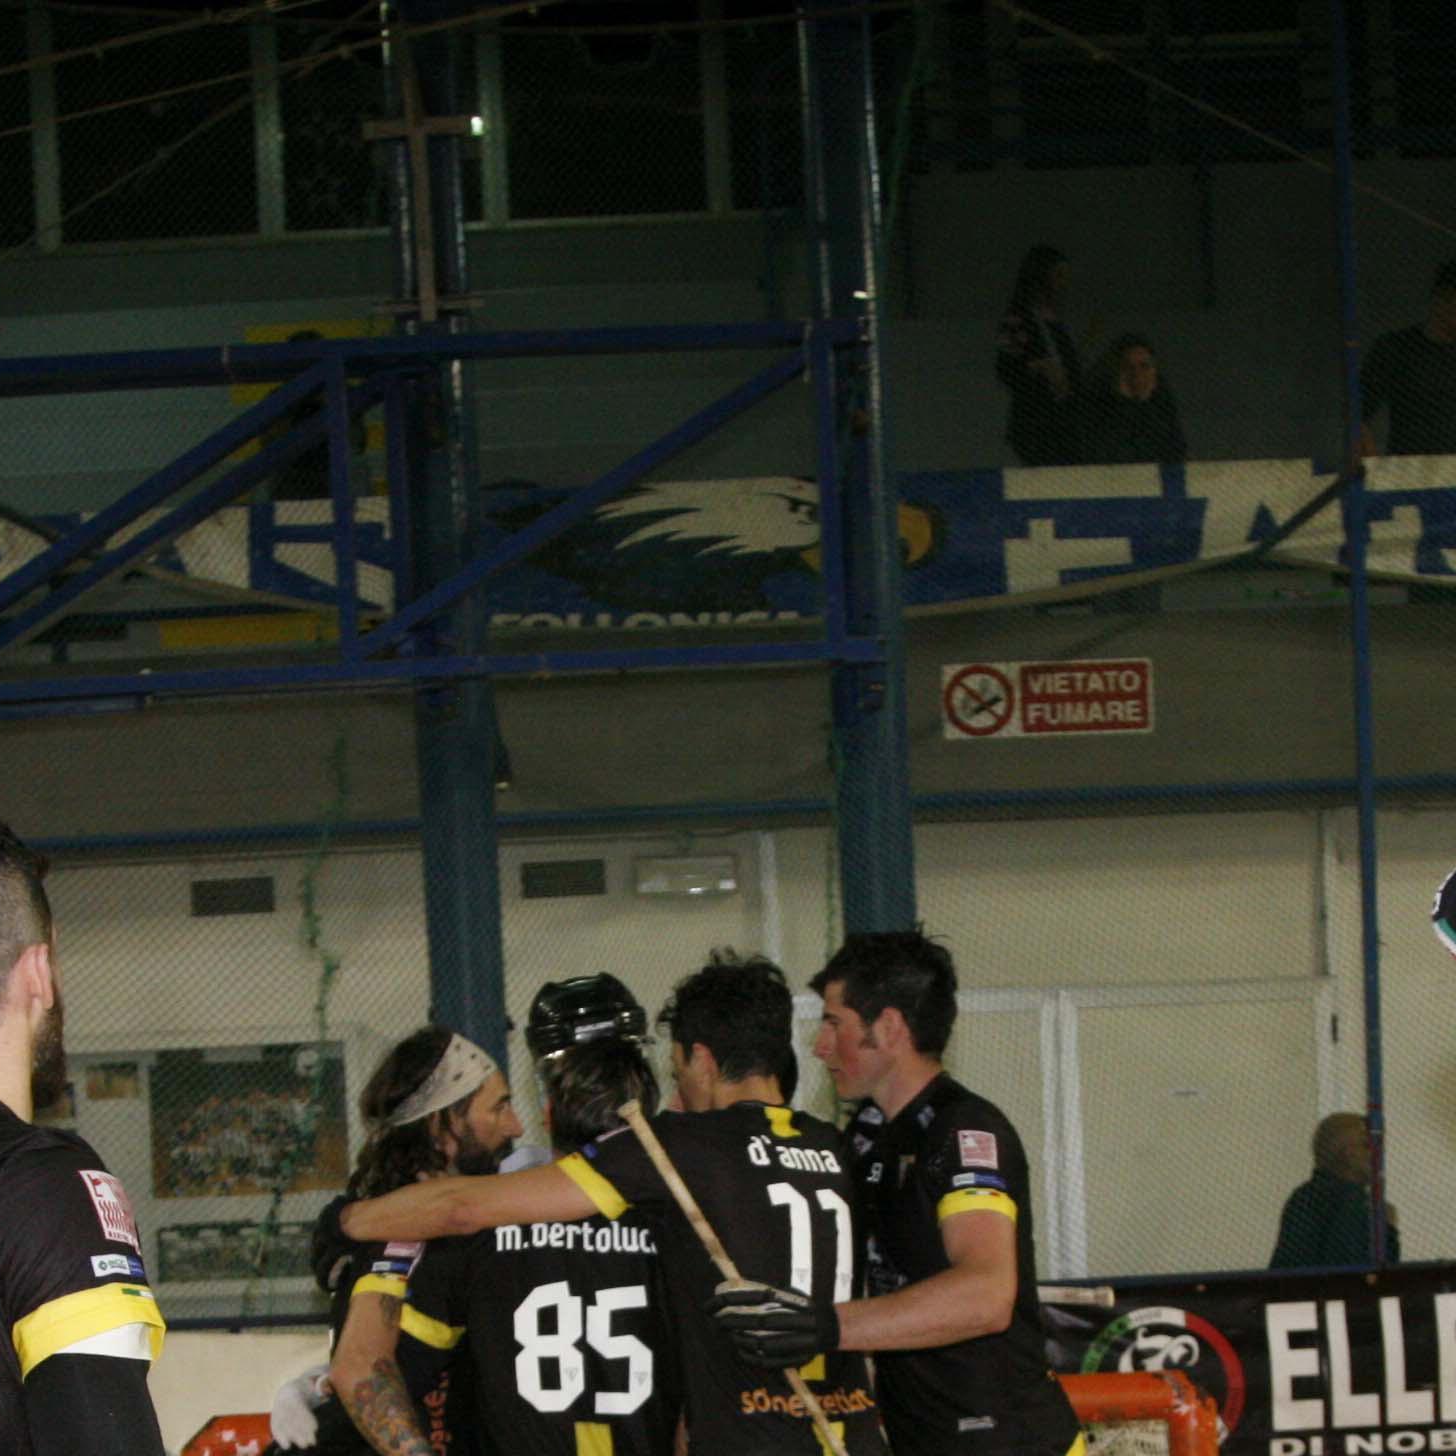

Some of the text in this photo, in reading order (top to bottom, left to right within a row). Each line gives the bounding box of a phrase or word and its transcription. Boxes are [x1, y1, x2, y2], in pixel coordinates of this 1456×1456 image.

[1026, 669, 1141, 695] VIETATO
[1026, 699, 1142, 726] FUMARE
[495, 1220, 658, 1255] m.bertoluc
[766, 1181, 855, 1305] 11
[512, 1279, 655, 1416] 85
